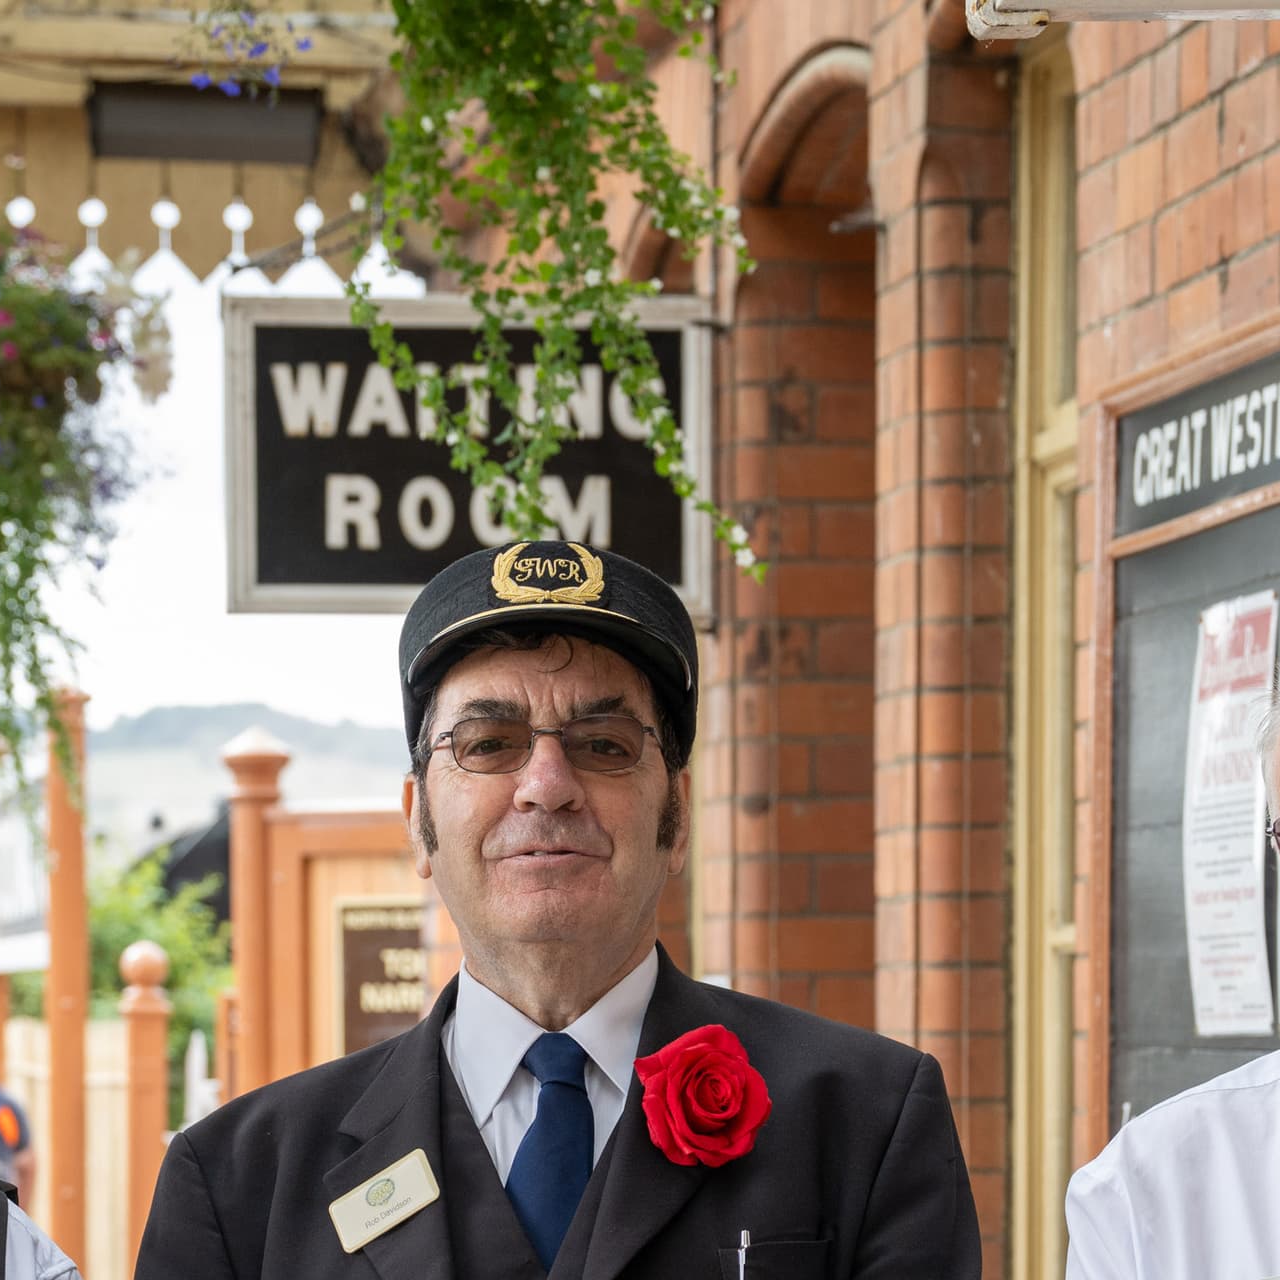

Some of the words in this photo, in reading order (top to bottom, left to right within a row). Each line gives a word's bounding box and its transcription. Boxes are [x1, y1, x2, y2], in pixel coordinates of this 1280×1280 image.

[270, 361, 666, 439] WAITING
[1133, 409, 1207, 506] GREAT
[324, 474, 611, 552] ROOM
[514, 557, 584, 583] GWR
